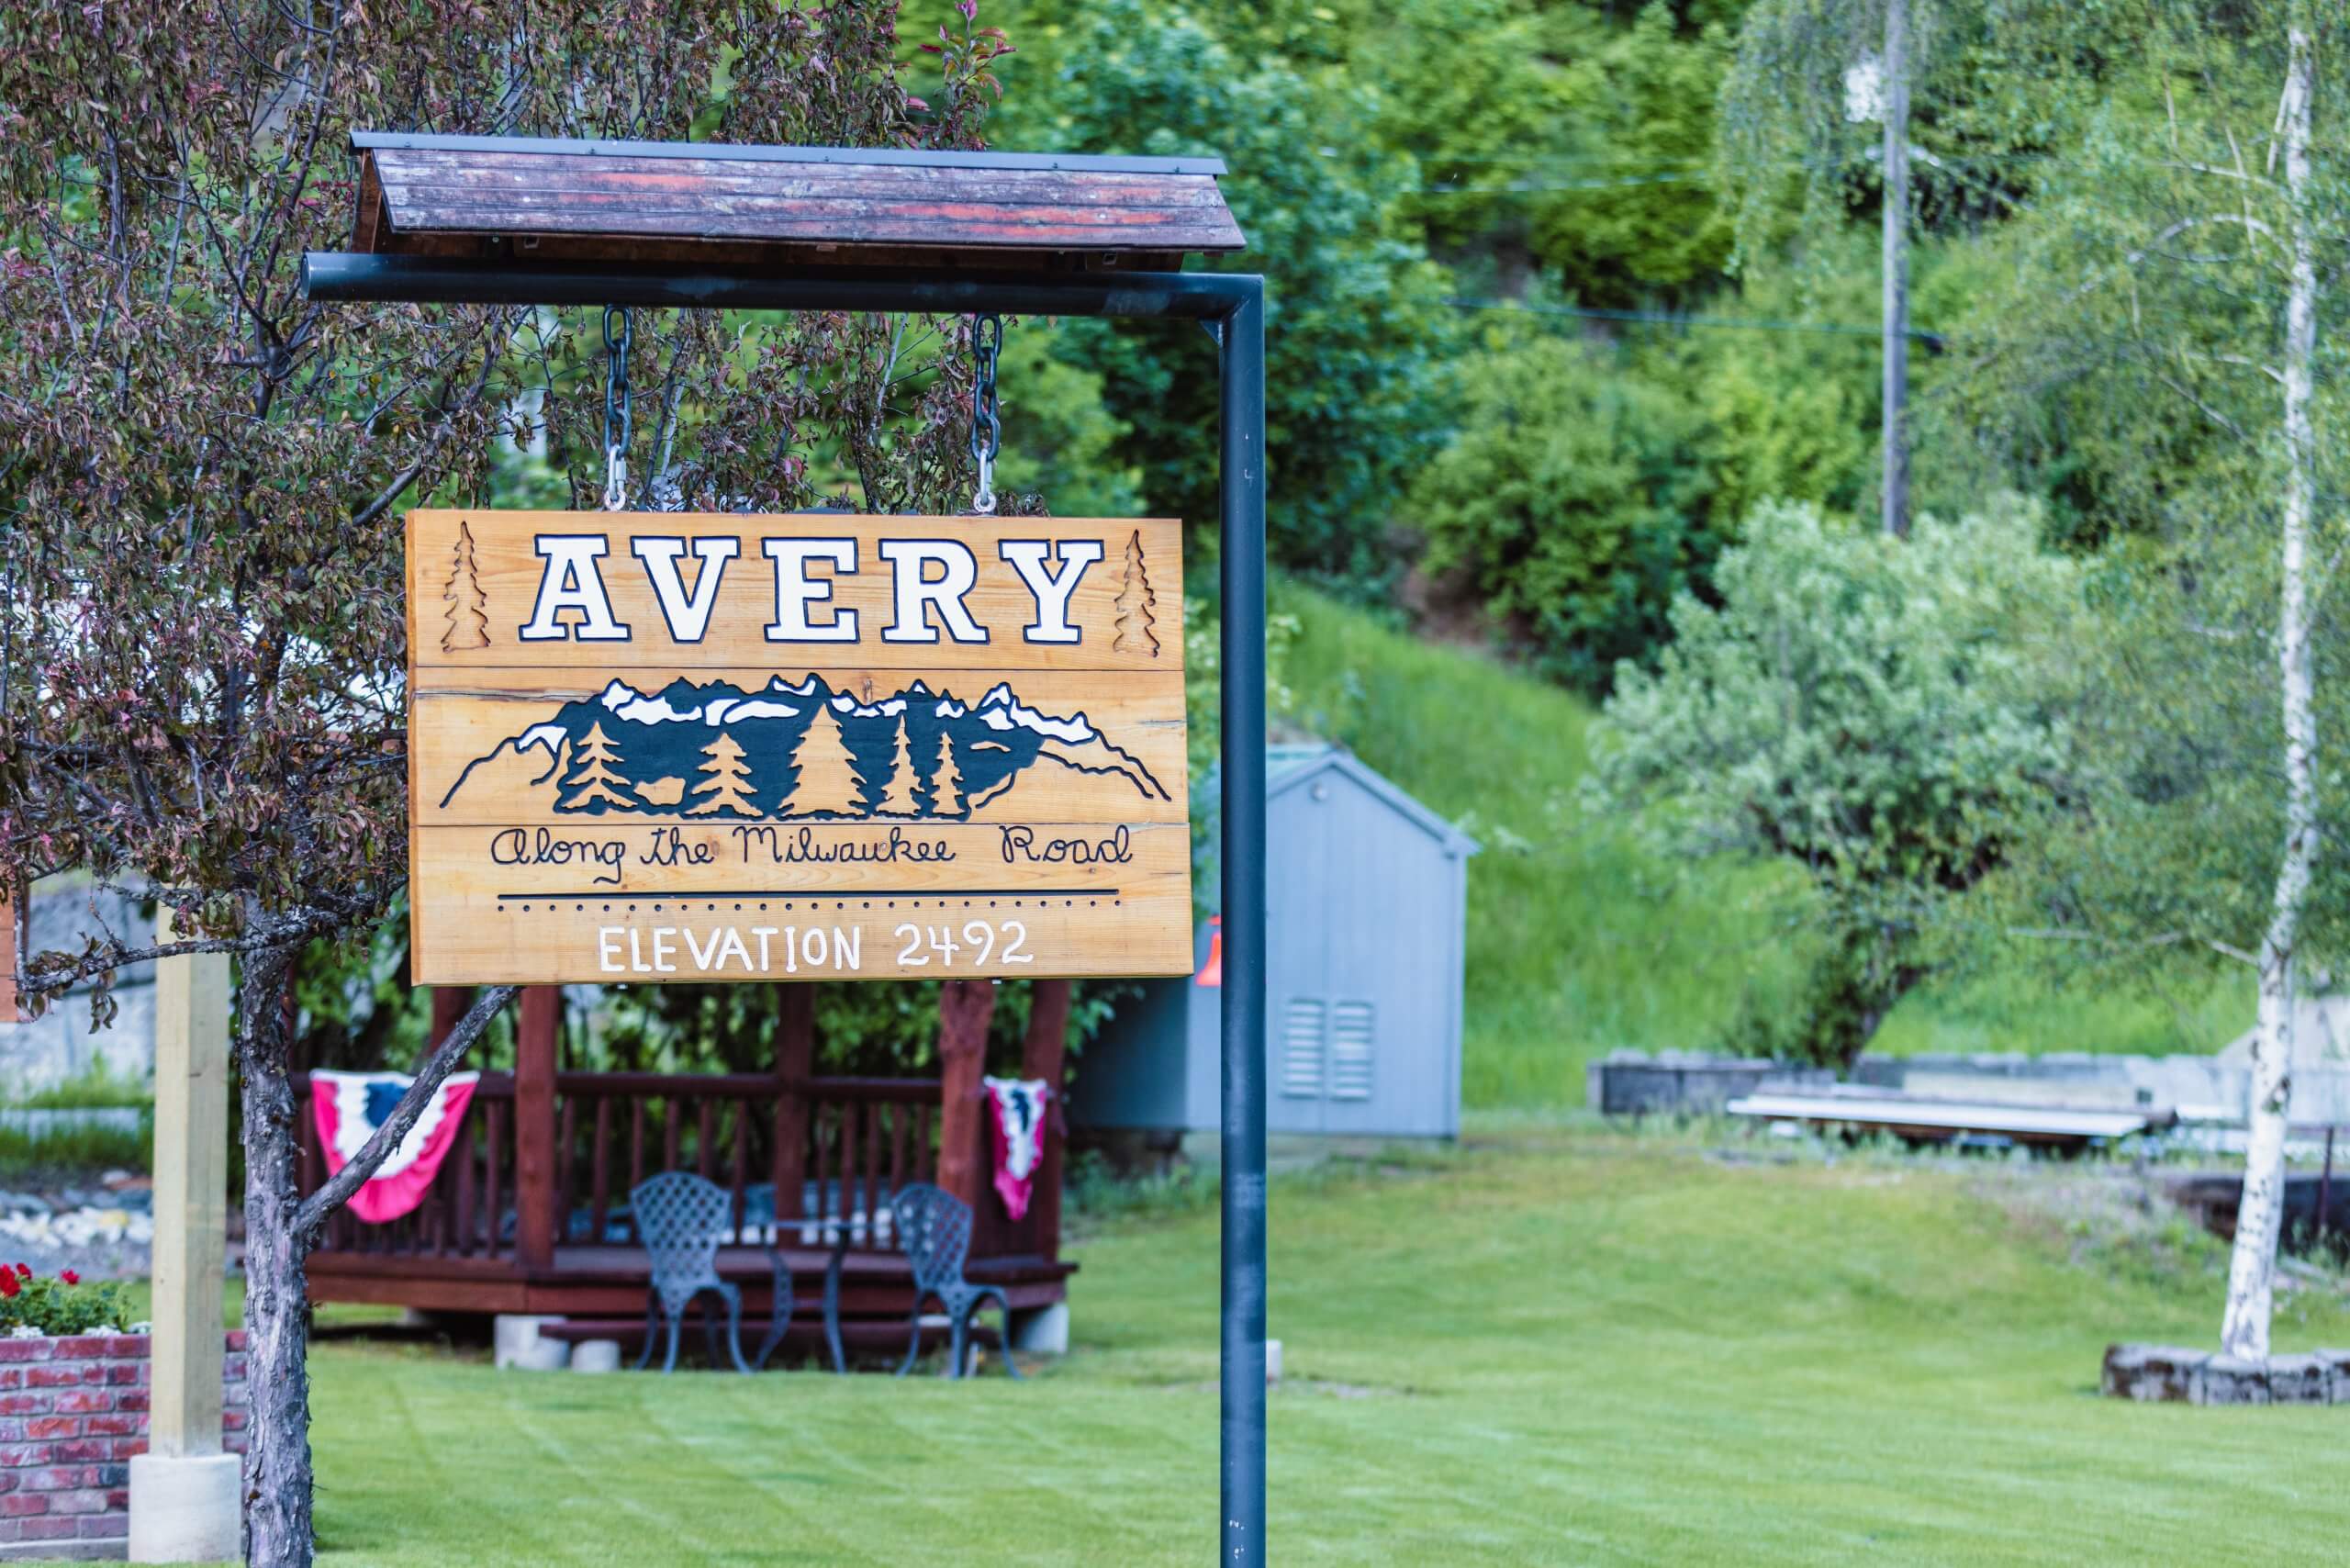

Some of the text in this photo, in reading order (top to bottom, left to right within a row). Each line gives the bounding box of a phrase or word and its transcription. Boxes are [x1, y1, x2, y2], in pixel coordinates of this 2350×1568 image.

[518, 533, 1105, 645] AVERY
[490, 825, 1134, 883] Along the Milwaukee Road
[599, 920, 1034, 974] ELEVATION 2492
